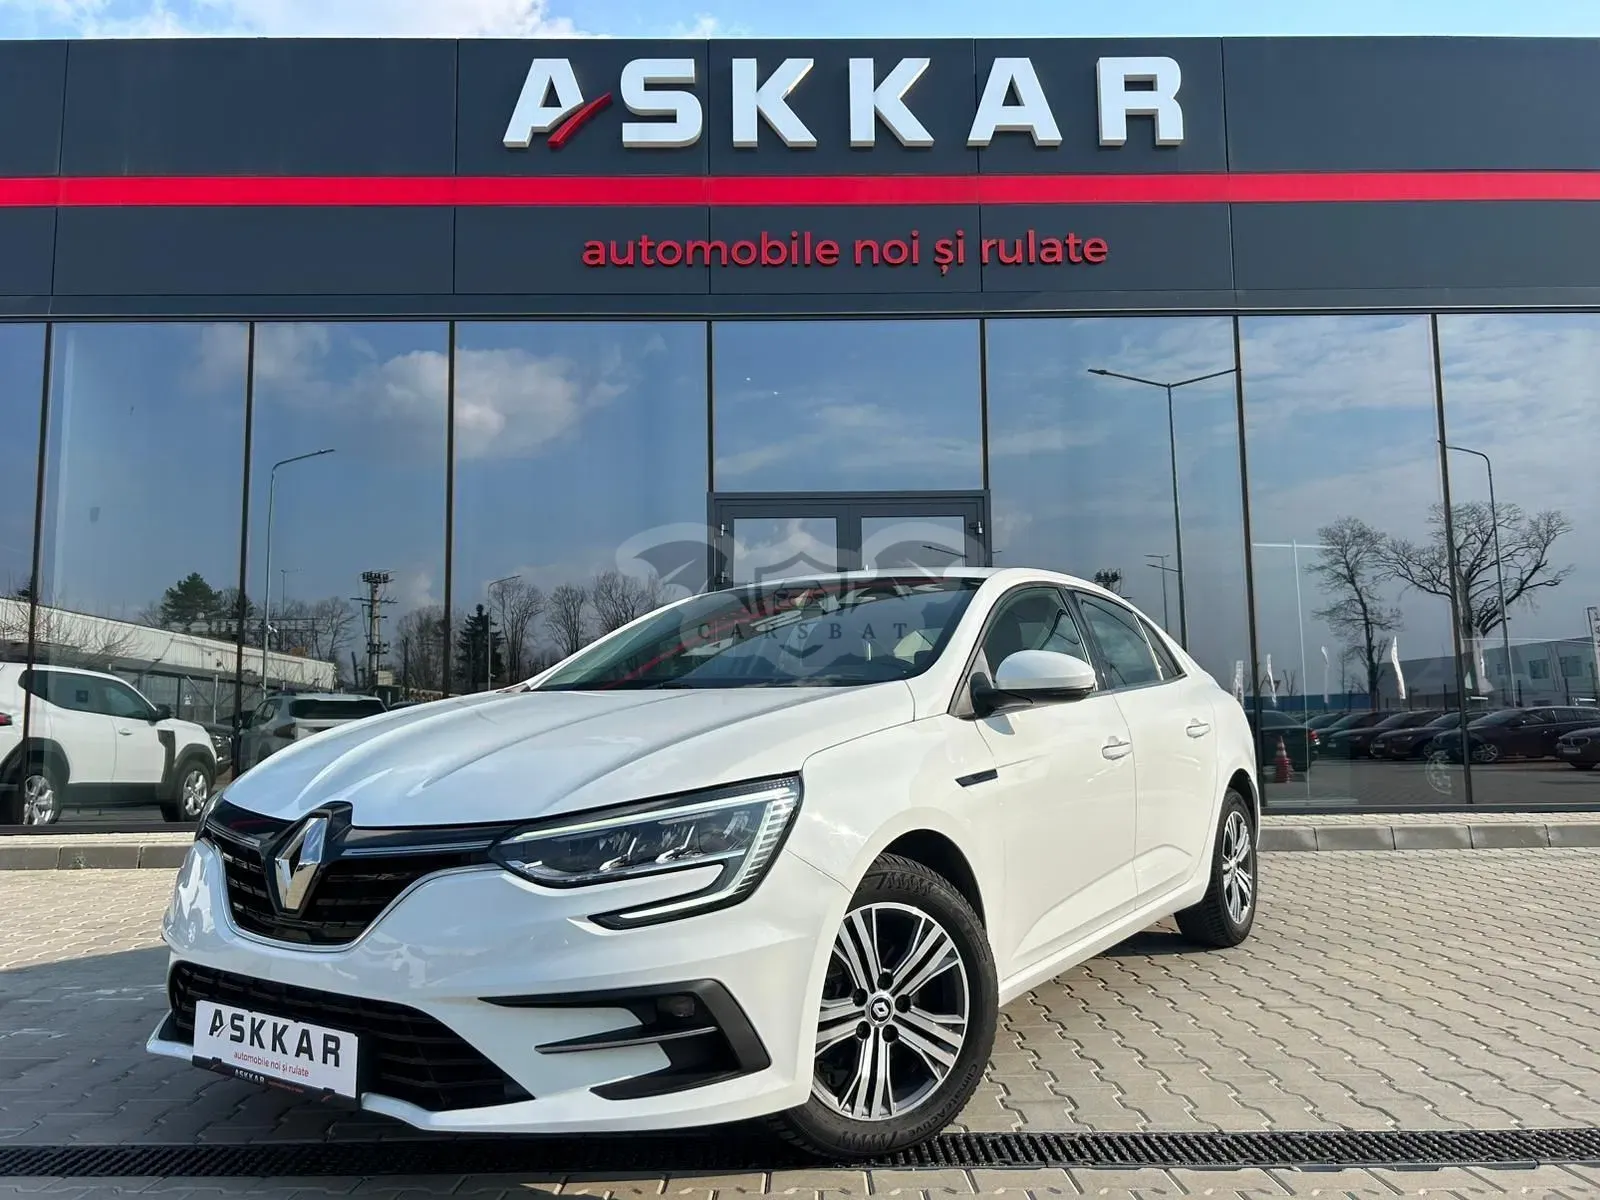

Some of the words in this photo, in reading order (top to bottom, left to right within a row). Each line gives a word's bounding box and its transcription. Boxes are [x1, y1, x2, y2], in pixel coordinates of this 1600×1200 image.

[502, 56, 1185, 149] ASKKAR
[582, 231, 840, 268] automobile
[853, 230, 919, 265] noi
[934, 230, 965, 276] și
[981, 229, 1109, 265] rulate
[209, 1008, 341, 1068] ASKKAR
[233, 1050, 269, 1067] automobile
[270, 1060, 281, 1071] noi
[288, 1064, 310, 1078] rulate
[234, 1068, 266, 1085] ASKKAR
